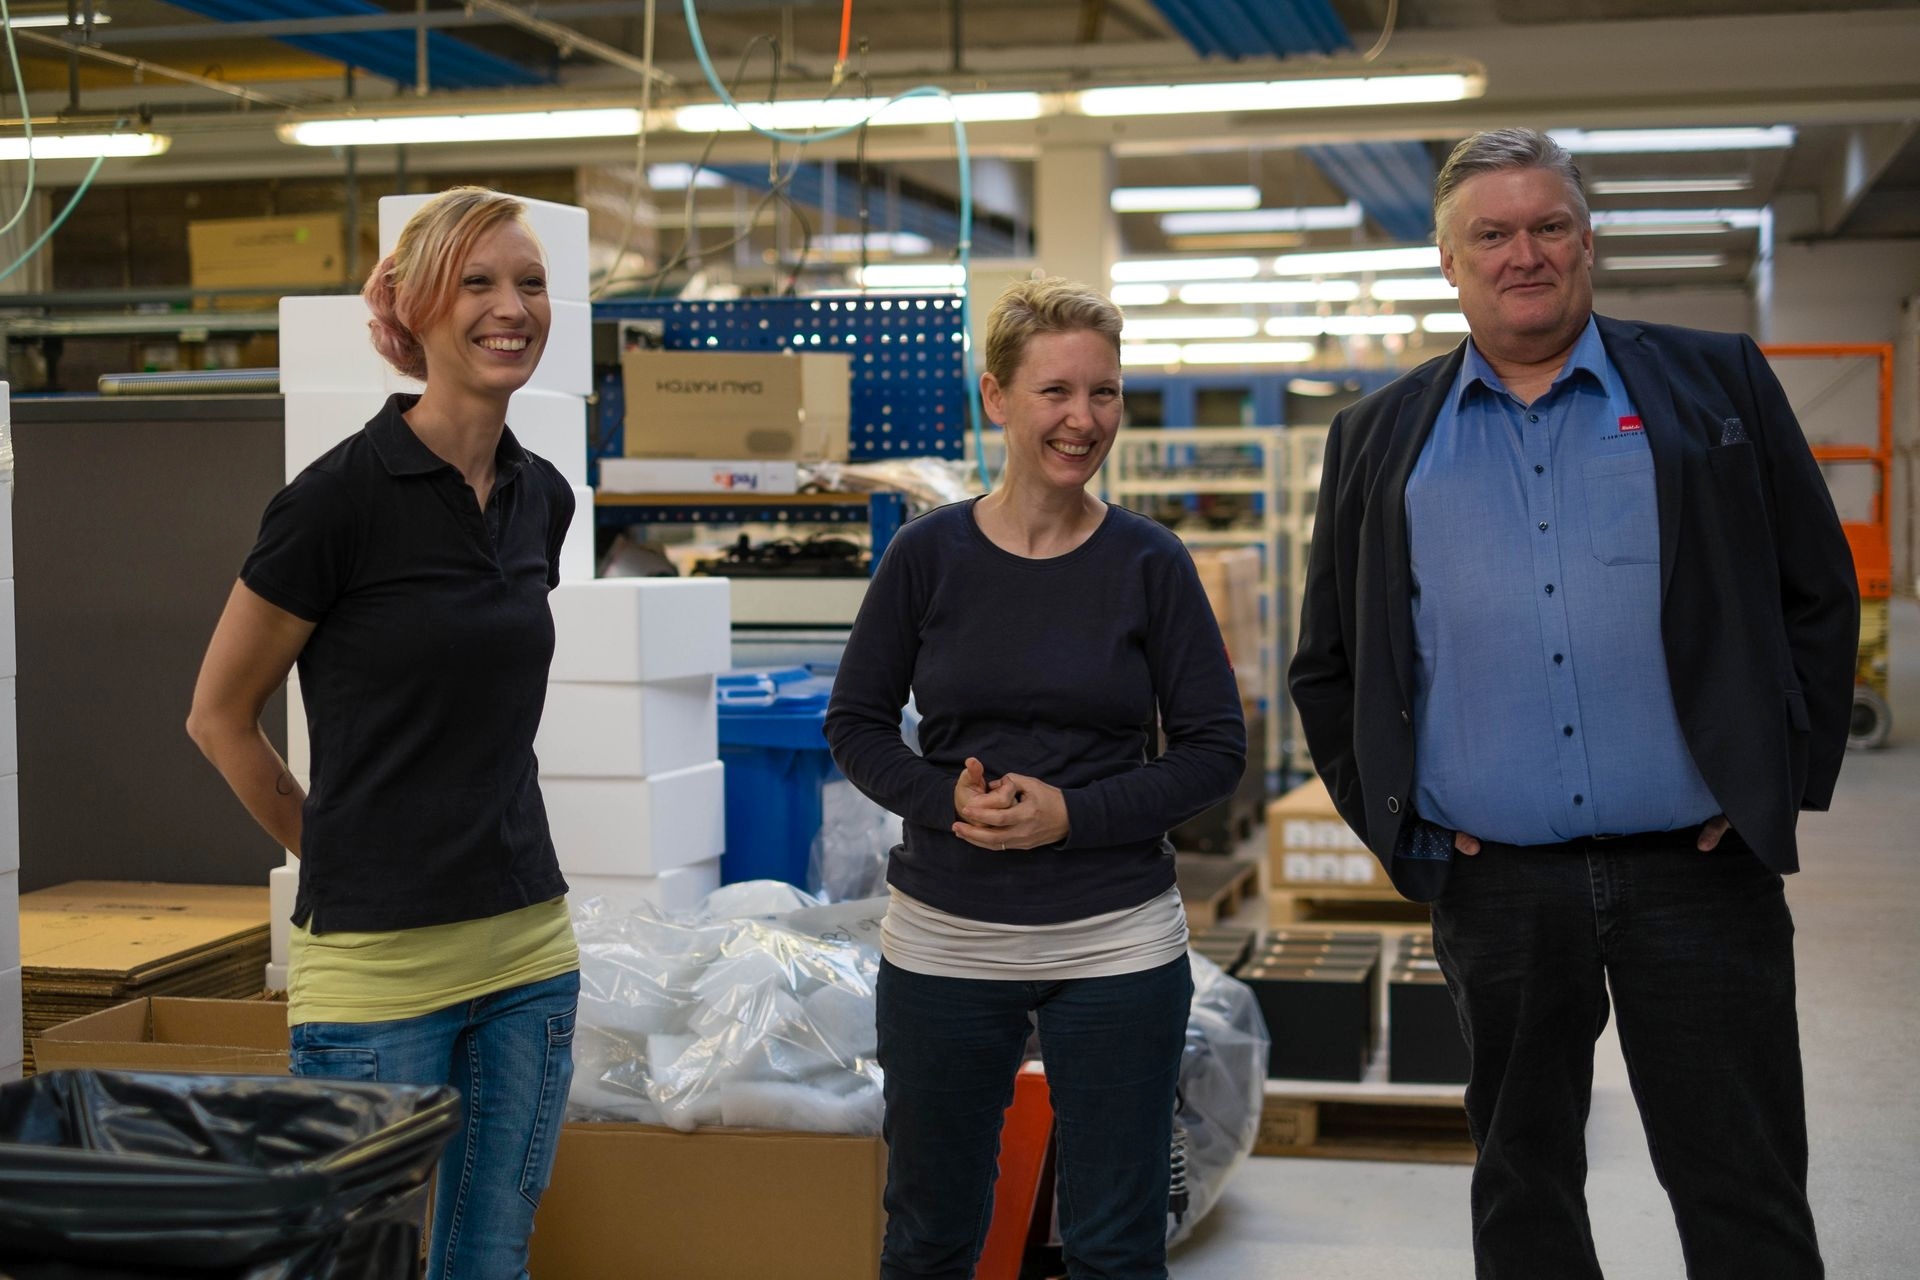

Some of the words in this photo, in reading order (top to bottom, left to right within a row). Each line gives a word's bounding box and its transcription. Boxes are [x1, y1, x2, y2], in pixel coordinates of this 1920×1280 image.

[656, 380, 718, 394] KATCH
[721, 381, 763, 395] DALI
[713, 473, 758, 489] FedEx
